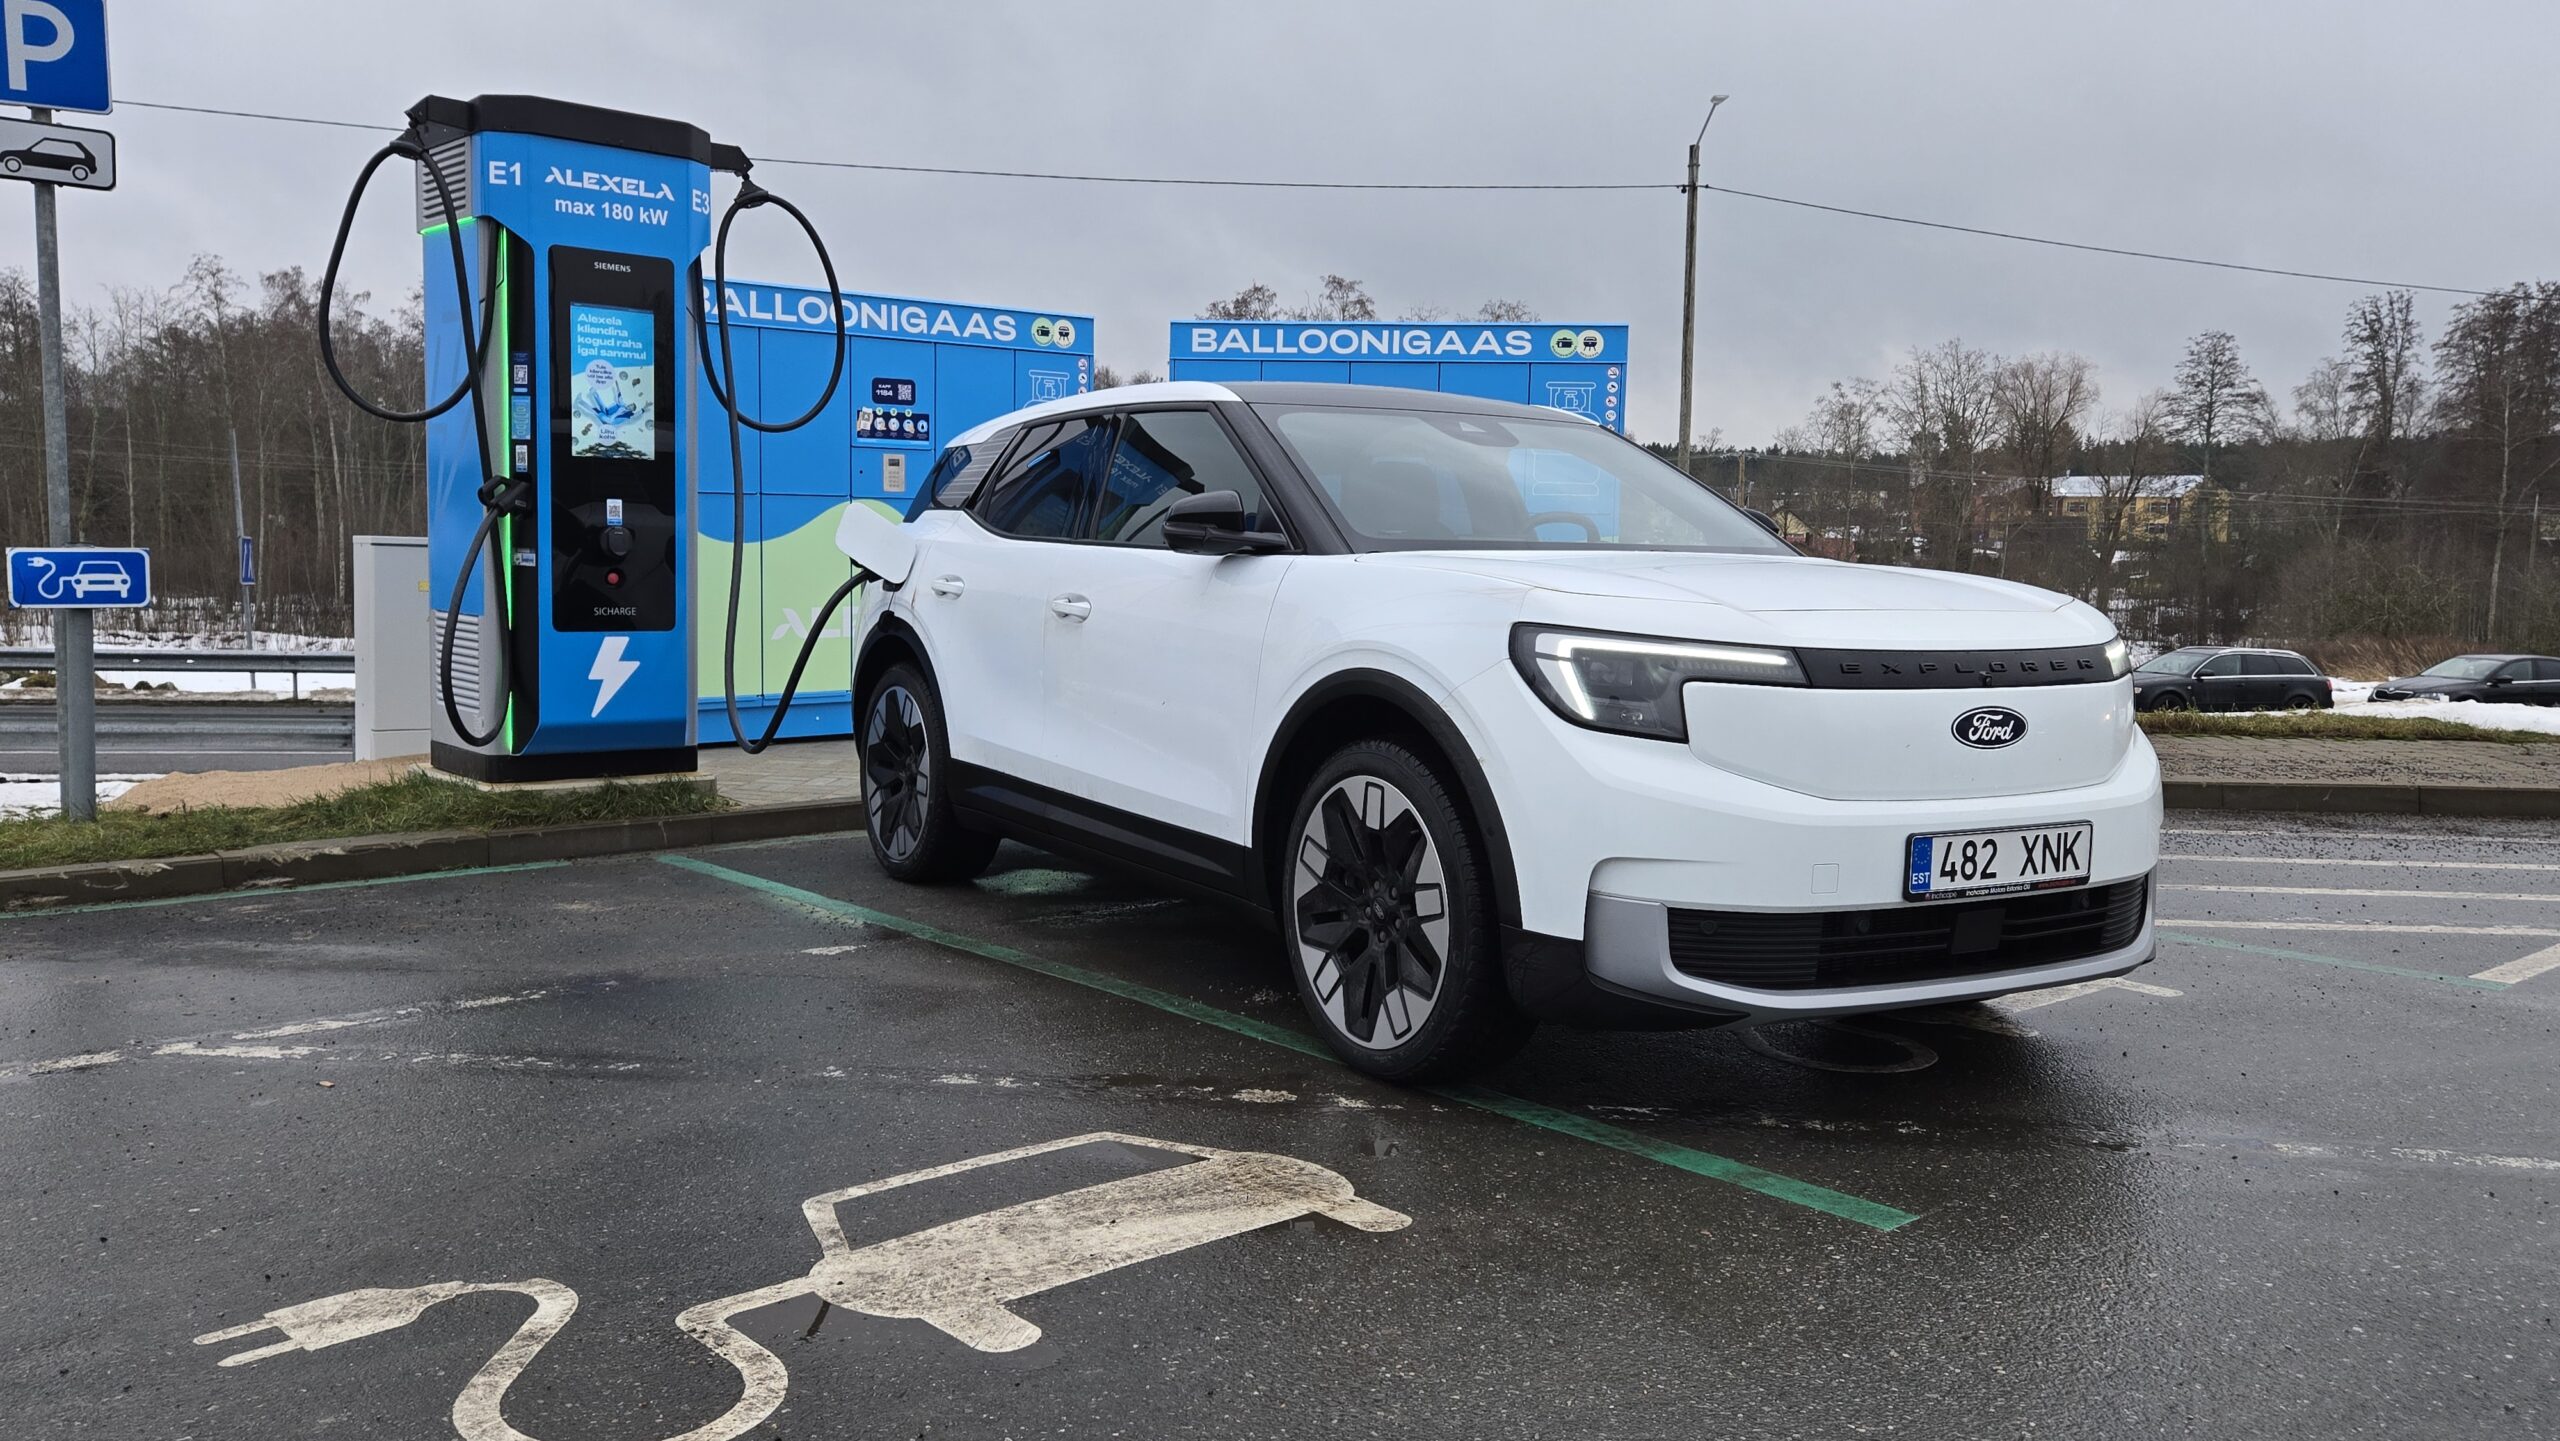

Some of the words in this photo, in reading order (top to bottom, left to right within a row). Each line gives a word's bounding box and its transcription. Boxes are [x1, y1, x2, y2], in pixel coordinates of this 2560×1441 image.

[4, 0, 75, 91] P
[488, 160, 521, 186] E1
[544, 166, 675, 201] ALEXELA
[555, 199, 595, 217] max
[601, 202, 634, 222] 180
[639, 206, 669, 226] kW
[692, 188, 710, 215] E3
[594, 261, 632, 273] SIEMENS
[577, 313, 623, 326] Alexela
[702, 285, 1017, 342] ALLOONIGAAS
[577, 324, 629, 337] kliendina
[577, 335, 615, 347] kogud
[616, 339, 643, 349] raha
[1191, 328, 1533, 356] BALLOONIGAAS
[577, 345, 598, 357] igal
[600, 348, 647, 360] sammul
[593, 607, 637, 616] SICHARGE
[1839, 658, 2096, 675] EXPLORER
[1968, 713, 2016, 742] Ford
[1939, 838, 1998, 883] 482
[2019, 830, 2083, 877] XNK
[1912, 872, 1931, 885] EST
